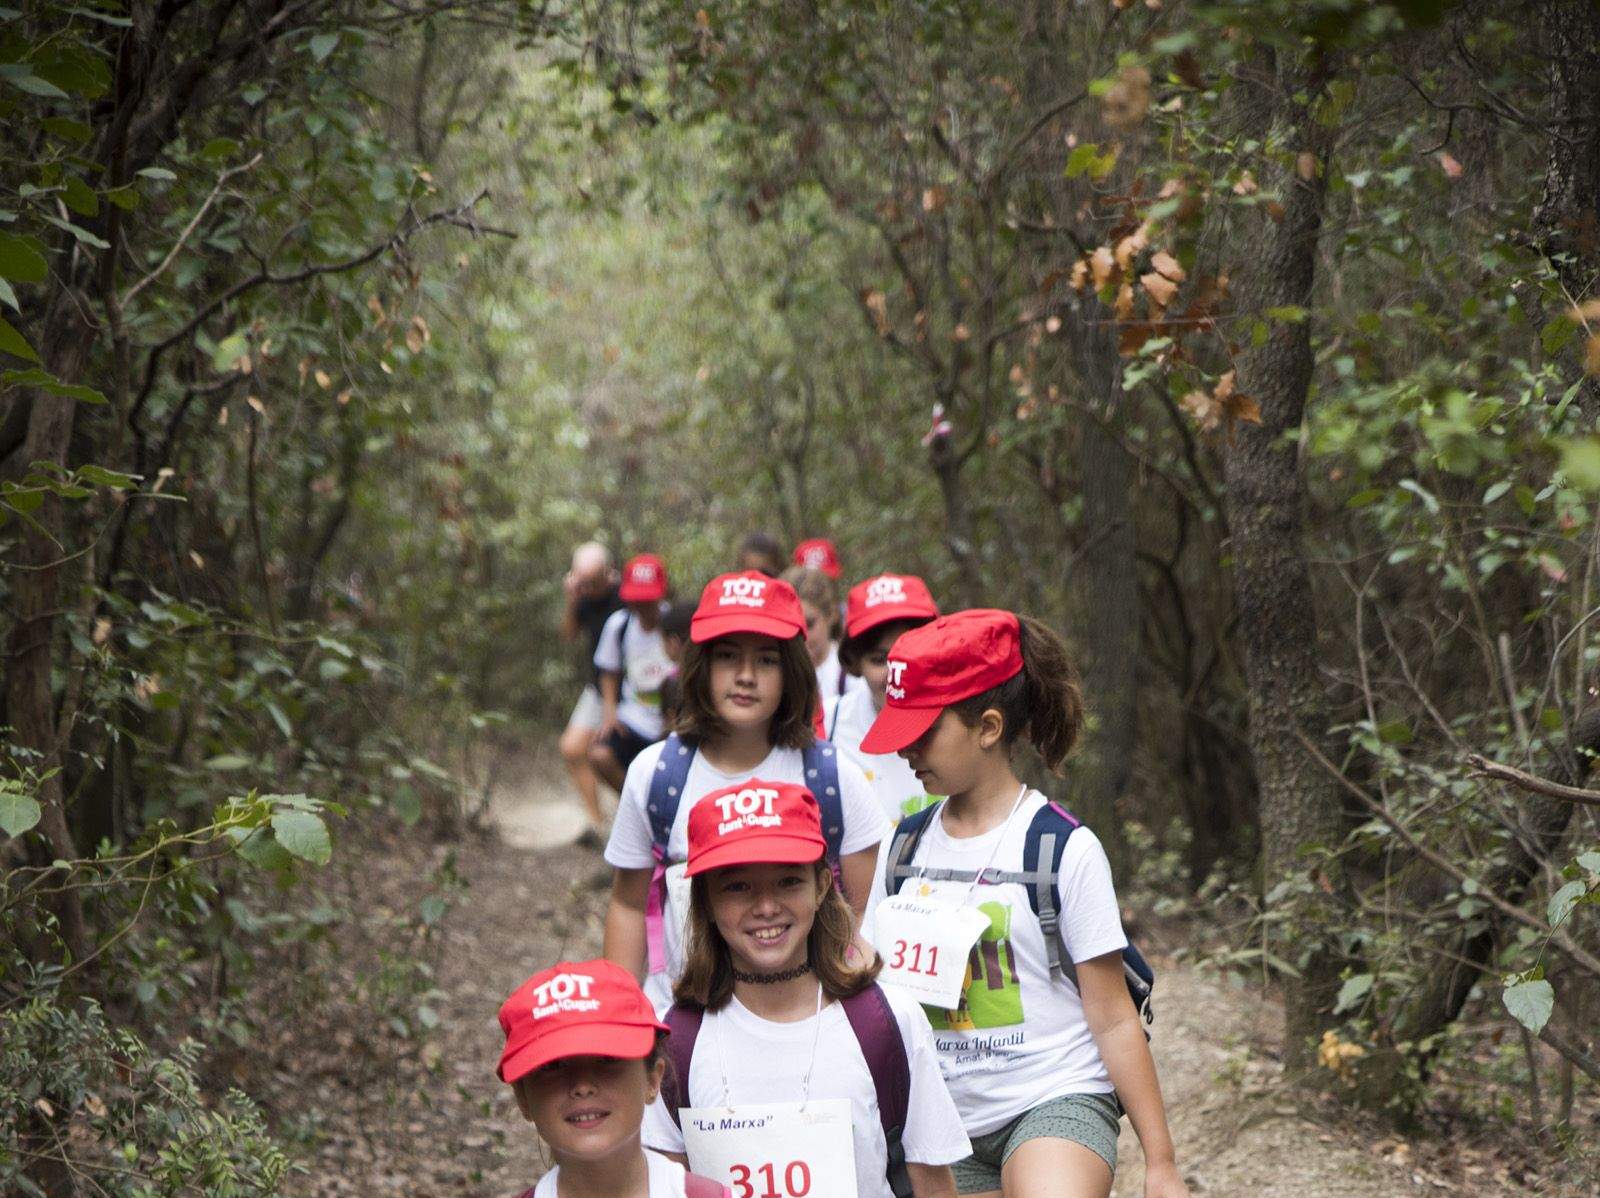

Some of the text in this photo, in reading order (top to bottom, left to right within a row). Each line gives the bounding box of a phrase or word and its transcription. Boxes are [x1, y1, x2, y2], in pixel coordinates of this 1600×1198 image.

[723, 577, 766, 597] TOT
[715, 788, 779, 821] TOT
[718, 813, 782, 836] Sant Cugat
[889, 939, 939, 977] 311
[533, 973, 594, 1006] TOT
[532, 999, 600, 1019] Sant Cugat
[971, 1032, 1025, 1050] Infantil
[693, 1115, 773, 1131] “La Marxa”
